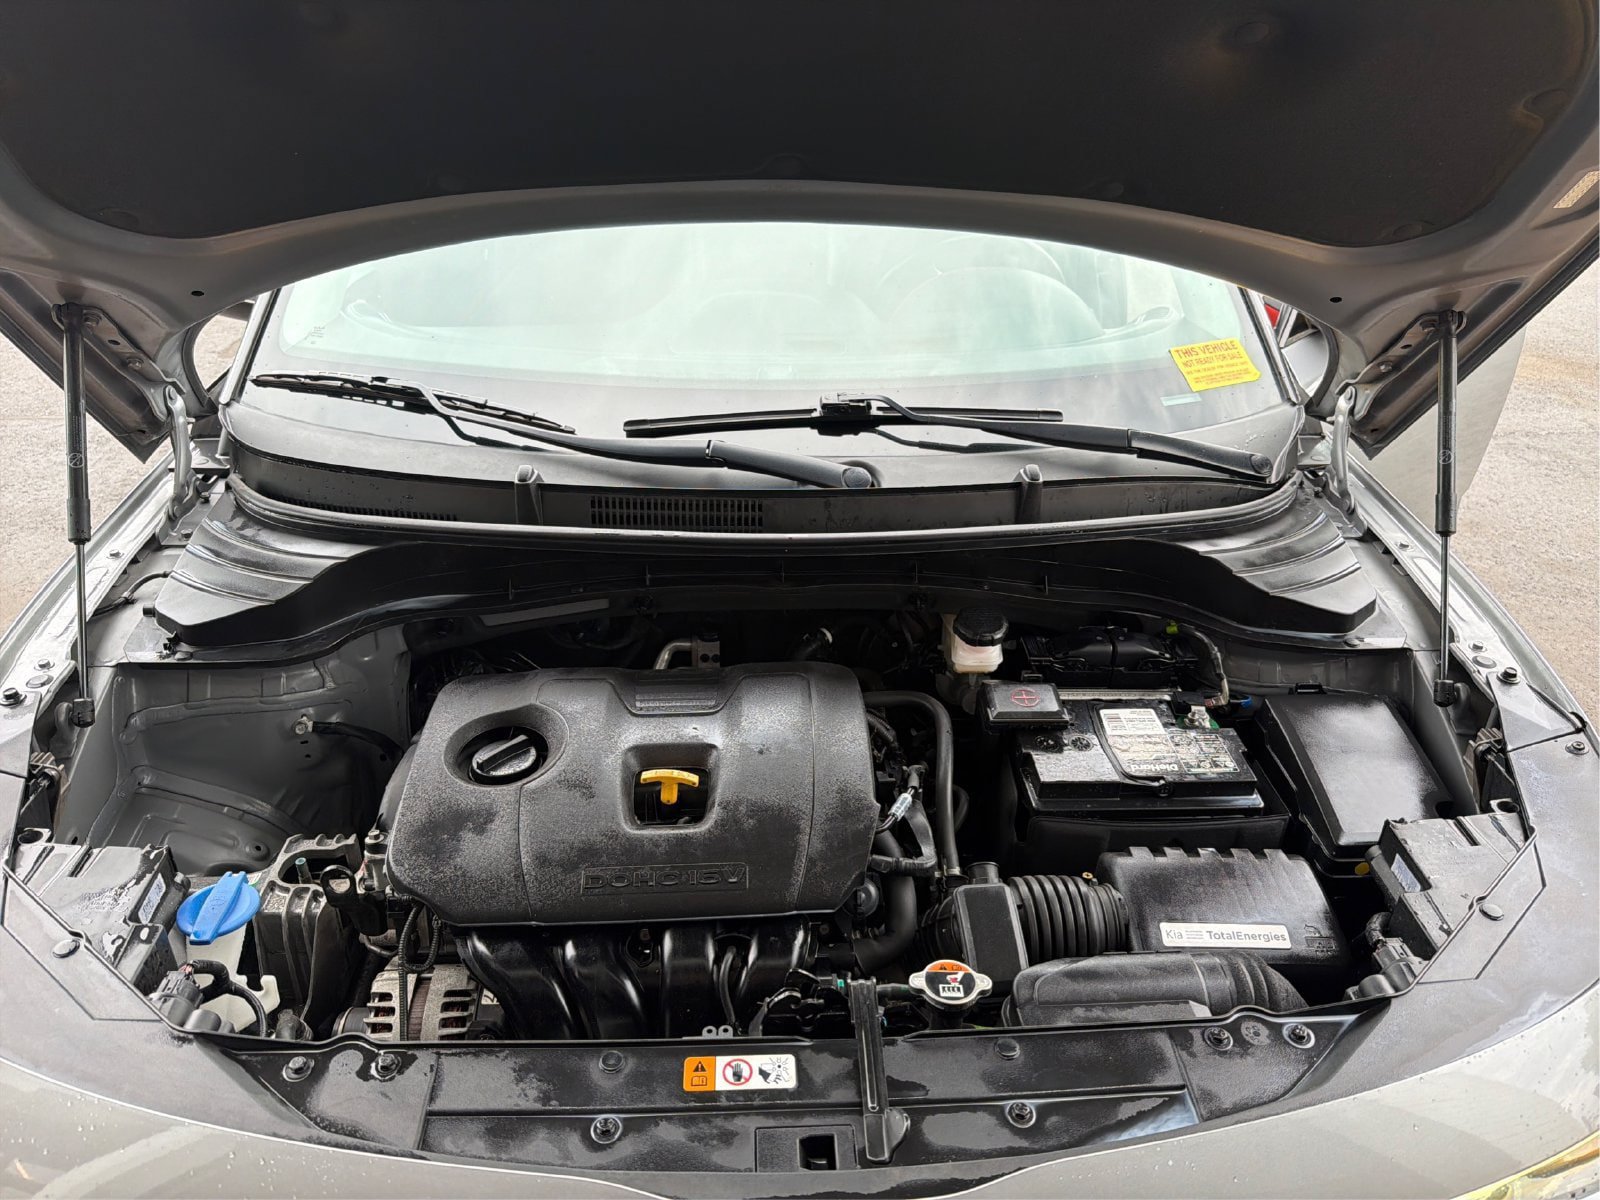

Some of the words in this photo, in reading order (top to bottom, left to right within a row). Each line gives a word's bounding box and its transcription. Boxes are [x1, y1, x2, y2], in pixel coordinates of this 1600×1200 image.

[1175, 346, 1199, 359] THIS
[1200, 341, 1238, 355] VEHICLE
[1182, 359, 1196, 368] NOT
[1195, 356, 1214, 366] READY
[1215, 354, 1229, 363] FOR
[1228, 352, 1243, 361] SALE
[1130, 761, 1179, 773] DieHard
[584, 870, 681, 889] DOHC
[1165, 929, 1184, 940] Kia
[1206, 930, 1287, 943] TotalEnergies
